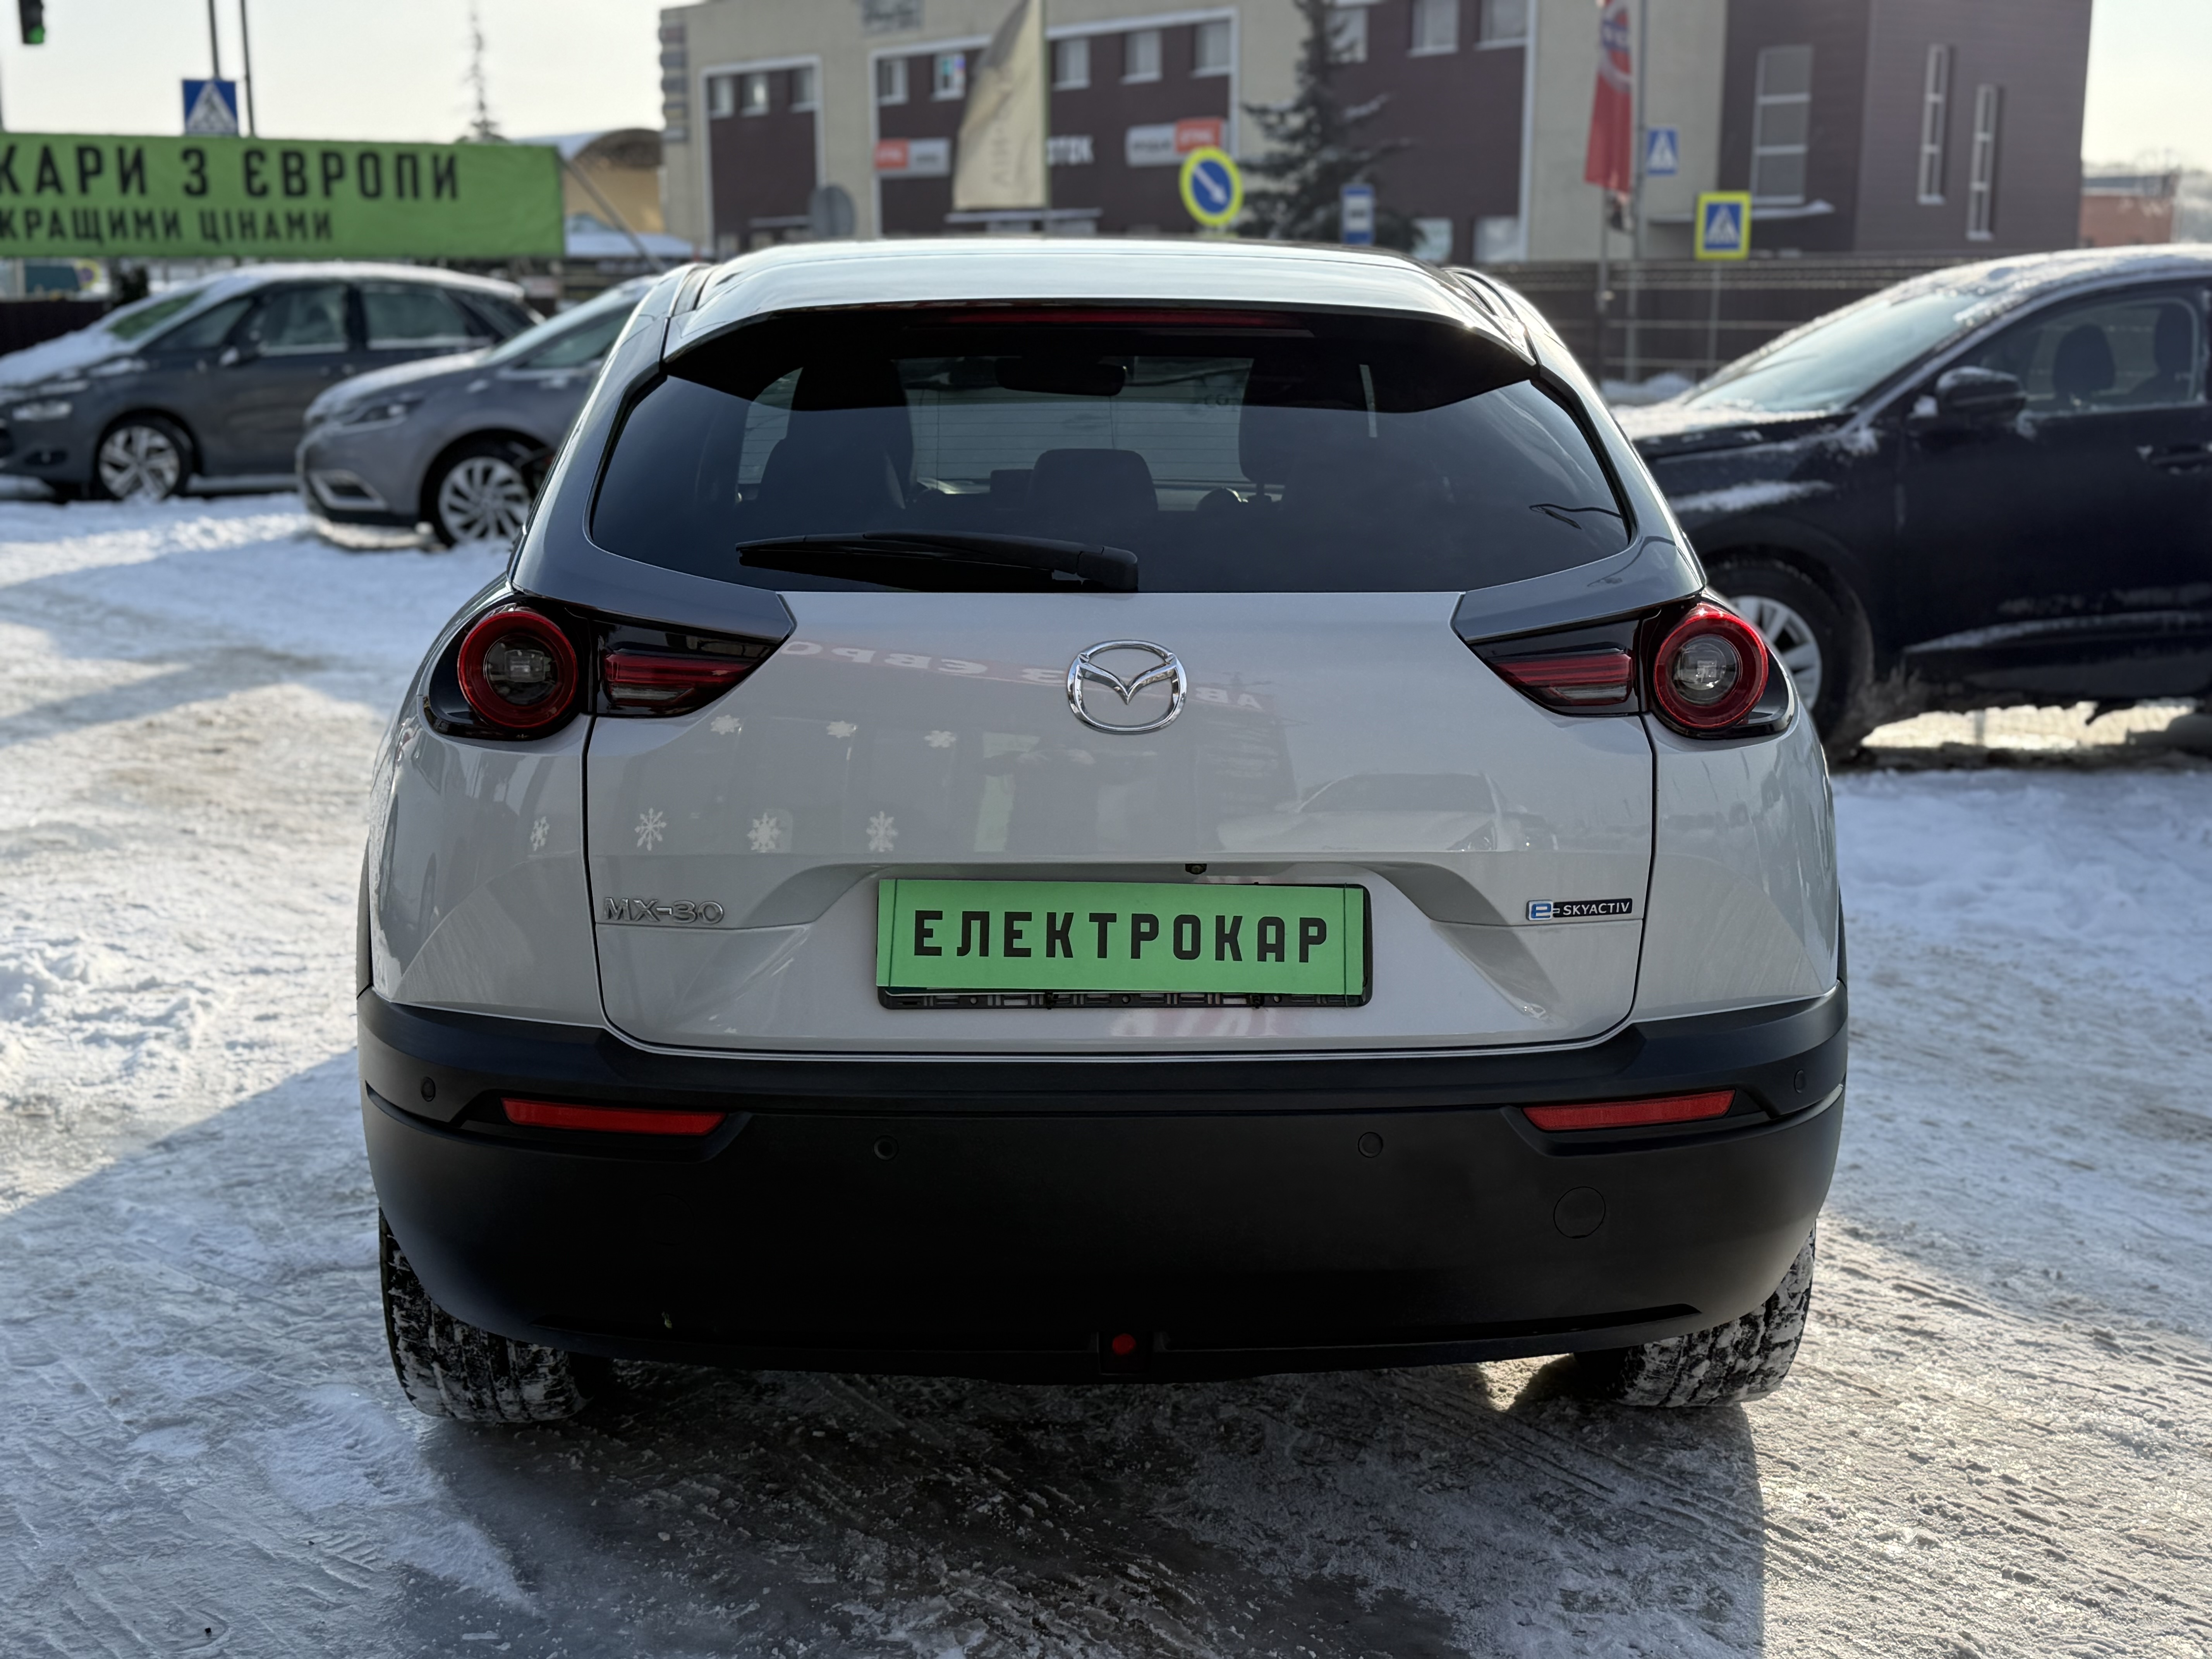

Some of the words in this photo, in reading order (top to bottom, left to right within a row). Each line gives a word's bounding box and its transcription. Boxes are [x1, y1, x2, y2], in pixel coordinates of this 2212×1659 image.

[182, 148, 208, 196] З
[243, 149, 458, 200] ЄВРОПИ
[199, 210, 333, 246] ЦІНАМИ
[603, 897, 724, 924] MX-30
[914, 910, 1327, 963] ЕЛЕКТРОКАР
